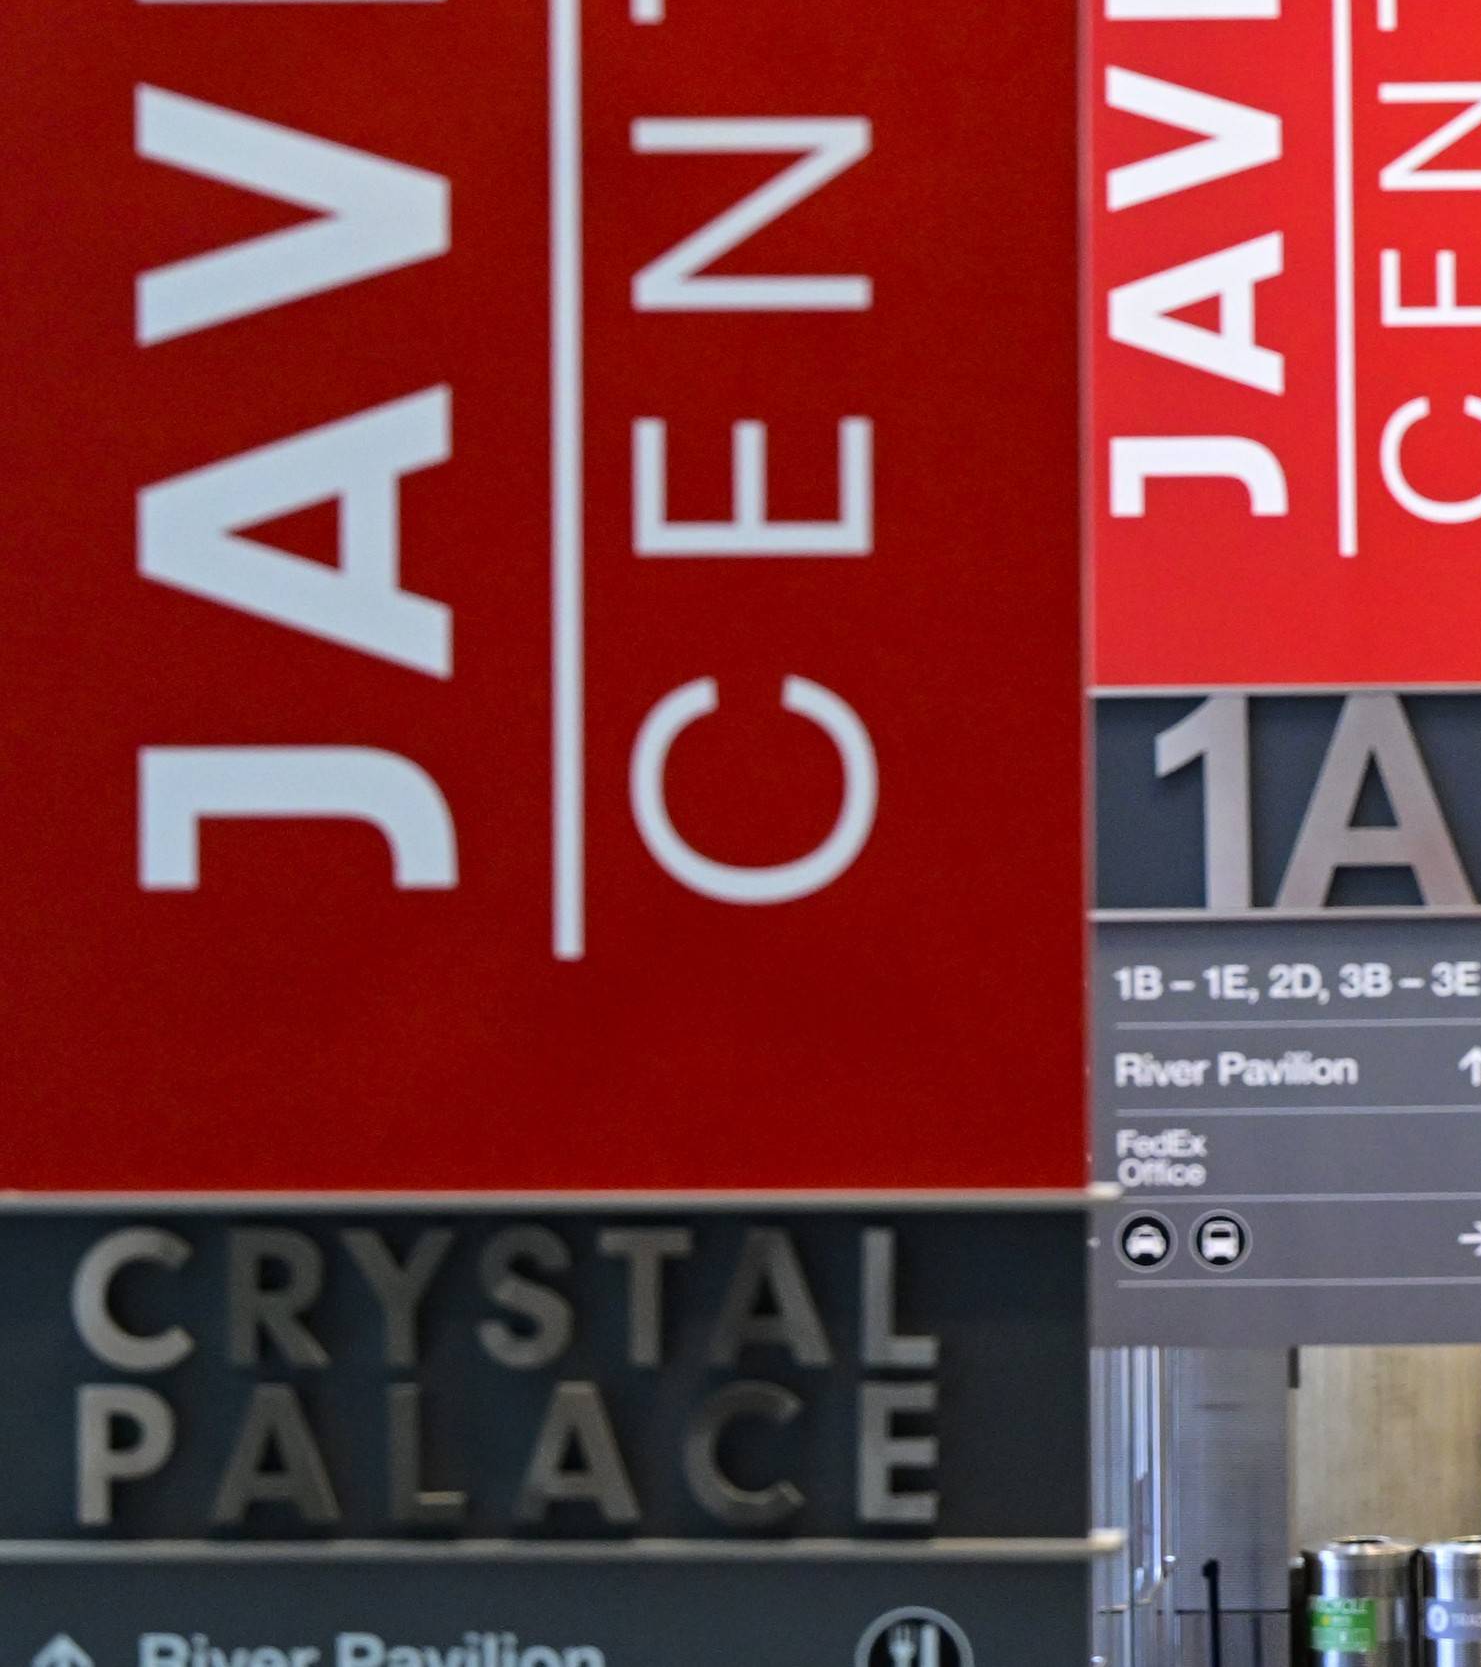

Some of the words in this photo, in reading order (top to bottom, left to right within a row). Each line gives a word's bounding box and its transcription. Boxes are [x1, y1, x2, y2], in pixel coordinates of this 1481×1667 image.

[1154, 693, 1477, 911] 1A
[1111, 964, 1164, 1001] 1B
[1202, 963, 1260, 1006] 1E,
[1267, 963, 1331, 1005] 2D,
[1338, 962, 1394, 998] 3B
[1114, 1051, 1211, 1087] River
[1216, 1050, 1359, 1087] Pavilion
[1115, 1128, 1208, 1158] FedEx
[1116, 1157, 1207, 1188] Office
[71, 1226, 940, 1373] CRYSTAL
[75, 1379, 940, 1527] PALACE
